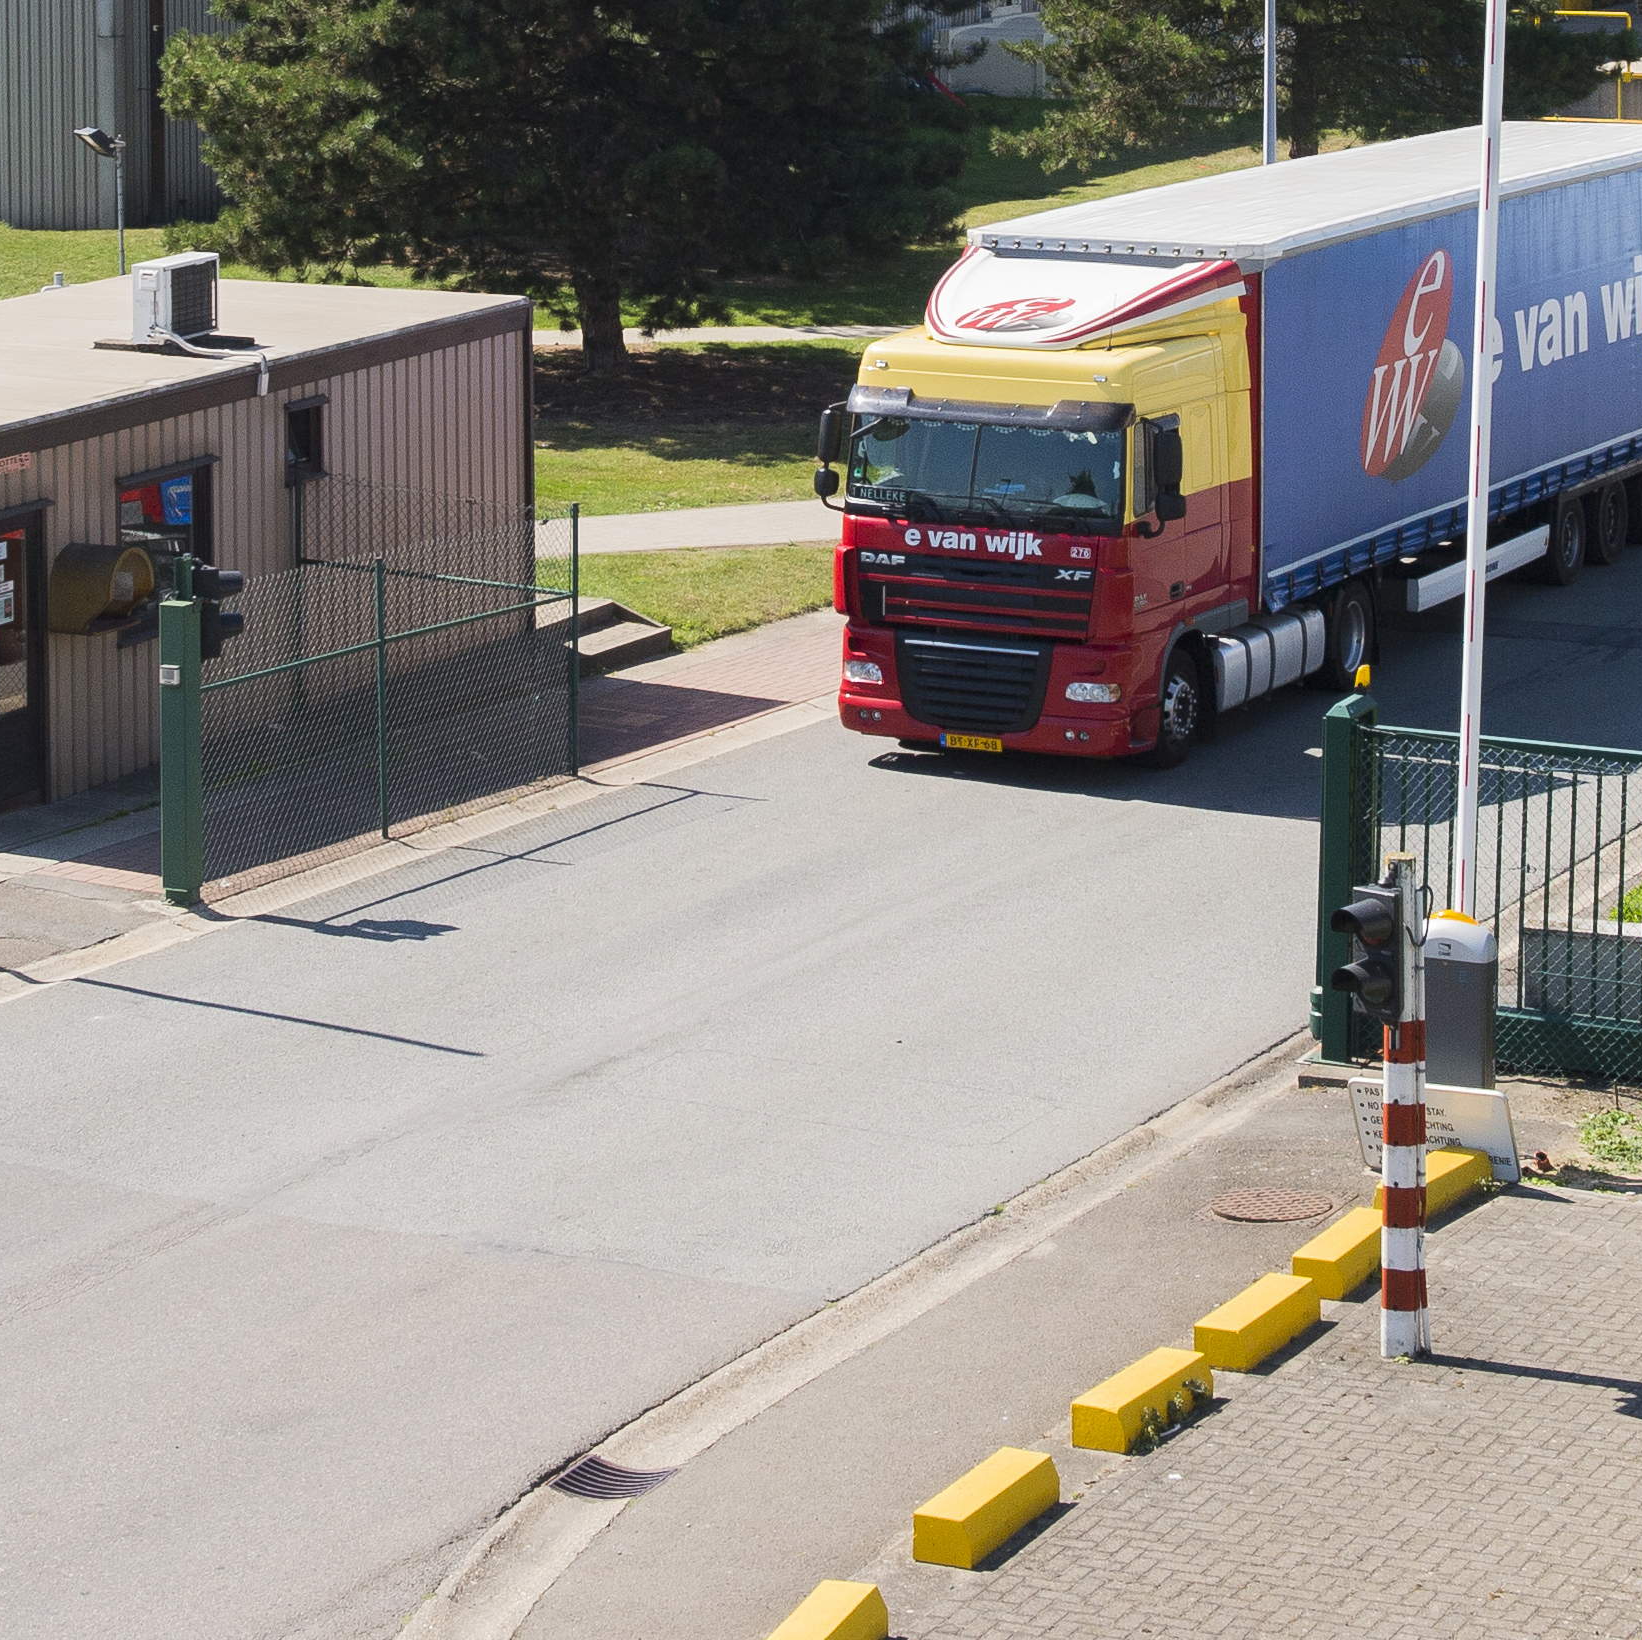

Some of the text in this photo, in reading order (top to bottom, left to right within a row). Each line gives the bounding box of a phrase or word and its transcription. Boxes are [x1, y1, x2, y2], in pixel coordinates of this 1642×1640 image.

[1514, 290, 1589, 371] van
[860, 488, 906, 502] NELLEKE
[905, 528, 1043, 560] e van wijk
[861, 551, 905, 566] DAF
[1054, 569, 1092, 581] XF
[1365, 1087, 1379, 1096] PAS
[1367, 1102, 1379, 1110] NO
[1427, 1106, 1447, 1118] STAY.
